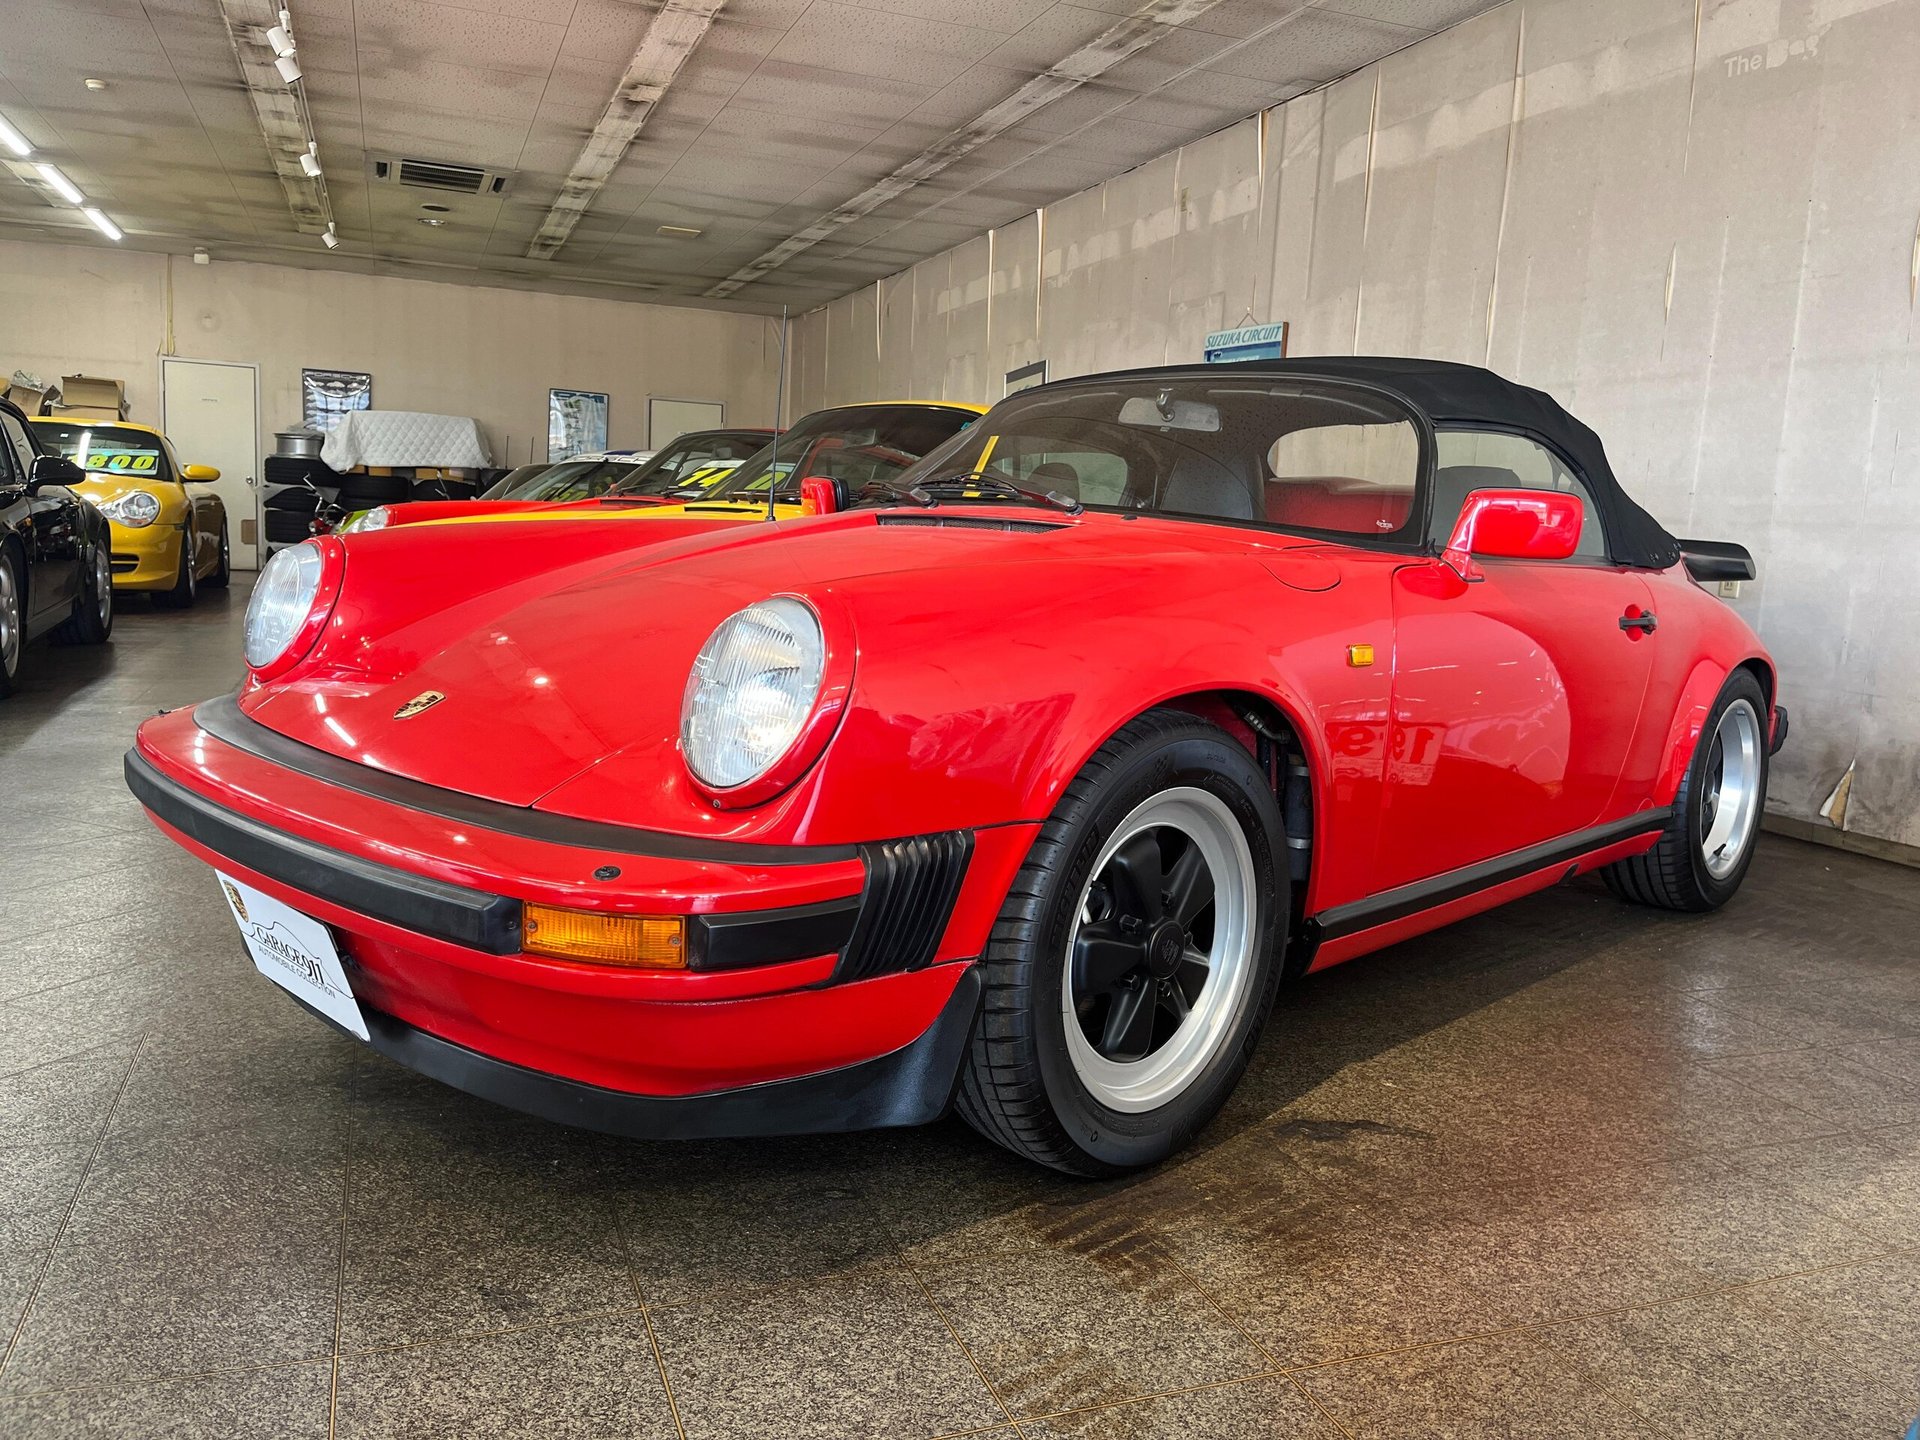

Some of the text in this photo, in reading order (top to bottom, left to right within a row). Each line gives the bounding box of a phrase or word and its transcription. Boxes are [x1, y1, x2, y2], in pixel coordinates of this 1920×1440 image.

[1724, 54, 1763, 78] The
[1206, 325, 1282, 348] SUZUKA CIRCUIT
[258, 944, 296, 974] AUTOMOBILE
